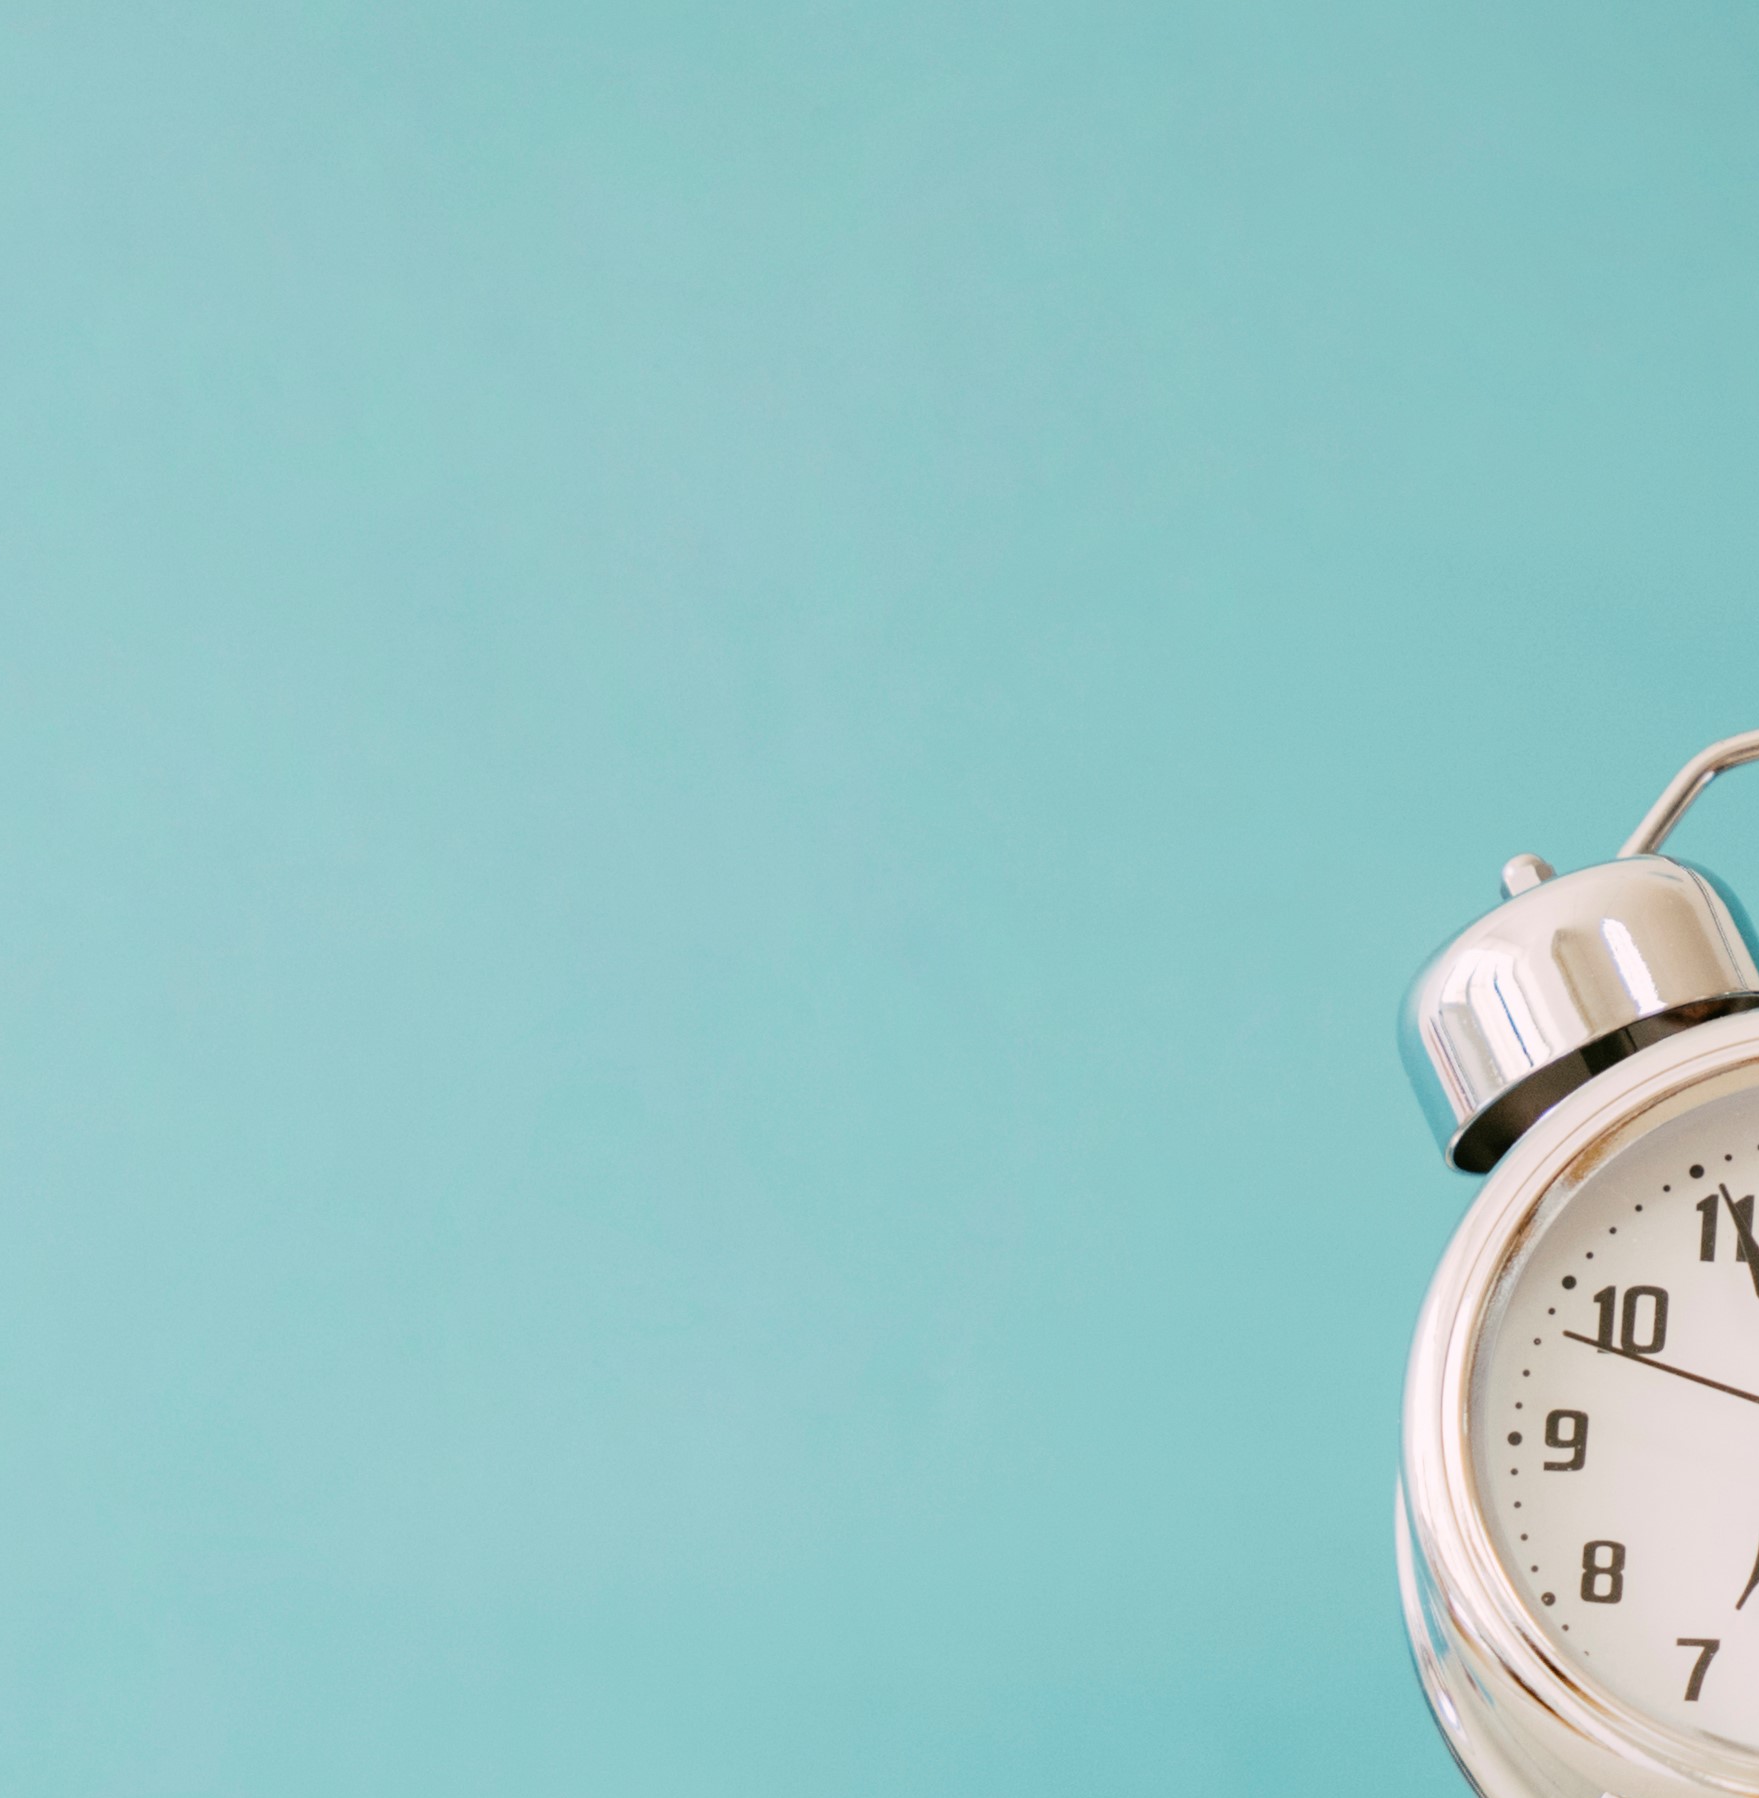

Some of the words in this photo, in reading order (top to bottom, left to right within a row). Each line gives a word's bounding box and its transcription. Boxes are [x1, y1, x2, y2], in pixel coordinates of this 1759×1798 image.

[1696, 1194, 1755, 1262] 11
[1592, 1285, 1670, 1355] 10
[1543, 1409, 1589, 1472] 9
[1580, 1540, 1626, 1604] 8
[1676, 1638, 1720, 1702] 7
